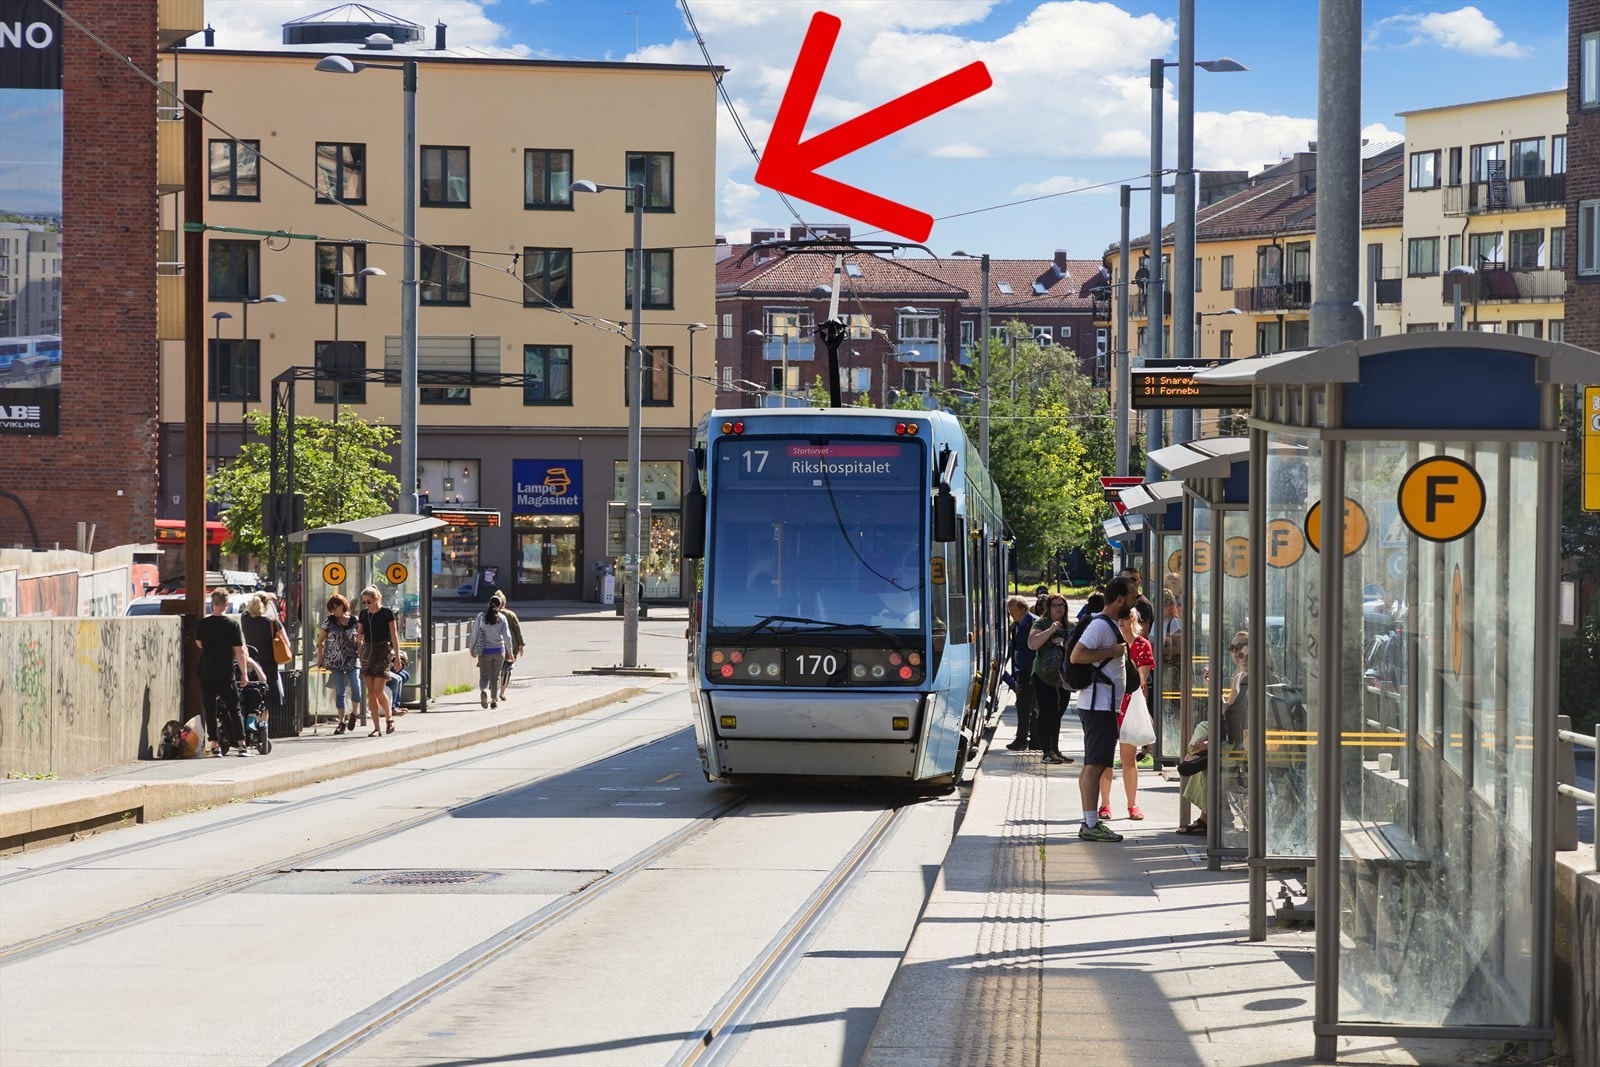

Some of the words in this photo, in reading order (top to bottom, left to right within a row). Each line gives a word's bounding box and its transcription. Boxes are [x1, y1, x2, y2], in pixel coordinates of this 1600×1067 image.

[0, 21, 53, 49] NO
[1144, 376, 1155, 384] 31
[1144, 387, 1155, 395] 31
[1160, 386, 1200, 395] Fornebu
[792, 447, 829, 455] Stortorvet
[742, 450, 769, 473] 17
[792, 460, 891, 477] Rikshospitalet
[517, 482, 556, 495] Lampe
[517, 494, 579, 508] Magasinet
[1425, 475, 1459, 523] F
[1271, 529, 1290, 557] F
[1230, 545, 1247, 569] F
[329, 567, 339, 581] C
[392, 567, 402, 580] C
[795, 654, 838, 675] 170
